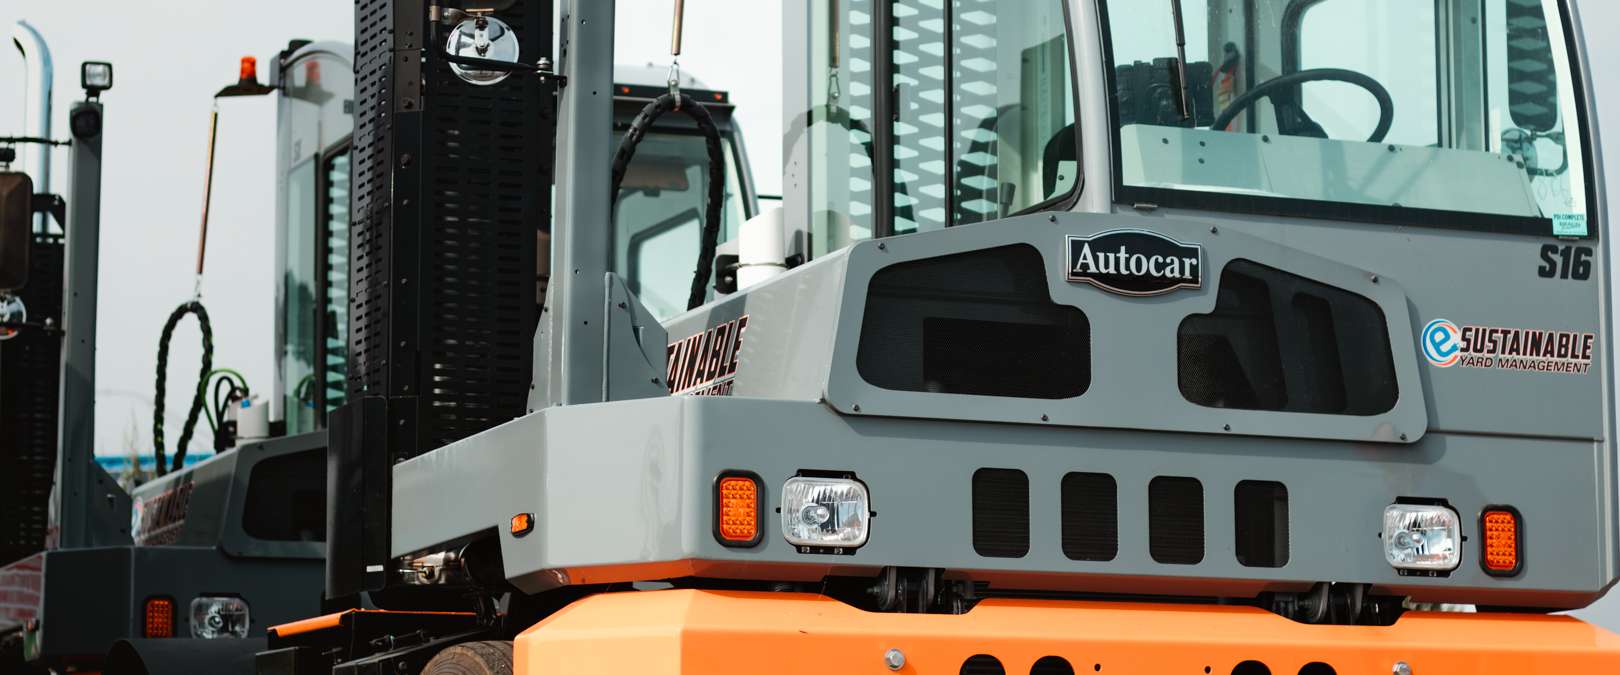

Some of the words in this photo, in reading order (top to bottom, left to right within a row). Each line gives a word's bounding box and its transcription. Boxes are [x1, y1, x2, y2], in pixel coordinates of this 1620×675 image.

[1073, 242, 1197, 279] Autocar
[1538, 244, 1593, 280] S16
[1460, 326, 1594, 360] SUSTAINABLE
[1460, 356, 1493, 368] YARD
[1498, 358, 1591, 373] MANAGEMENT
